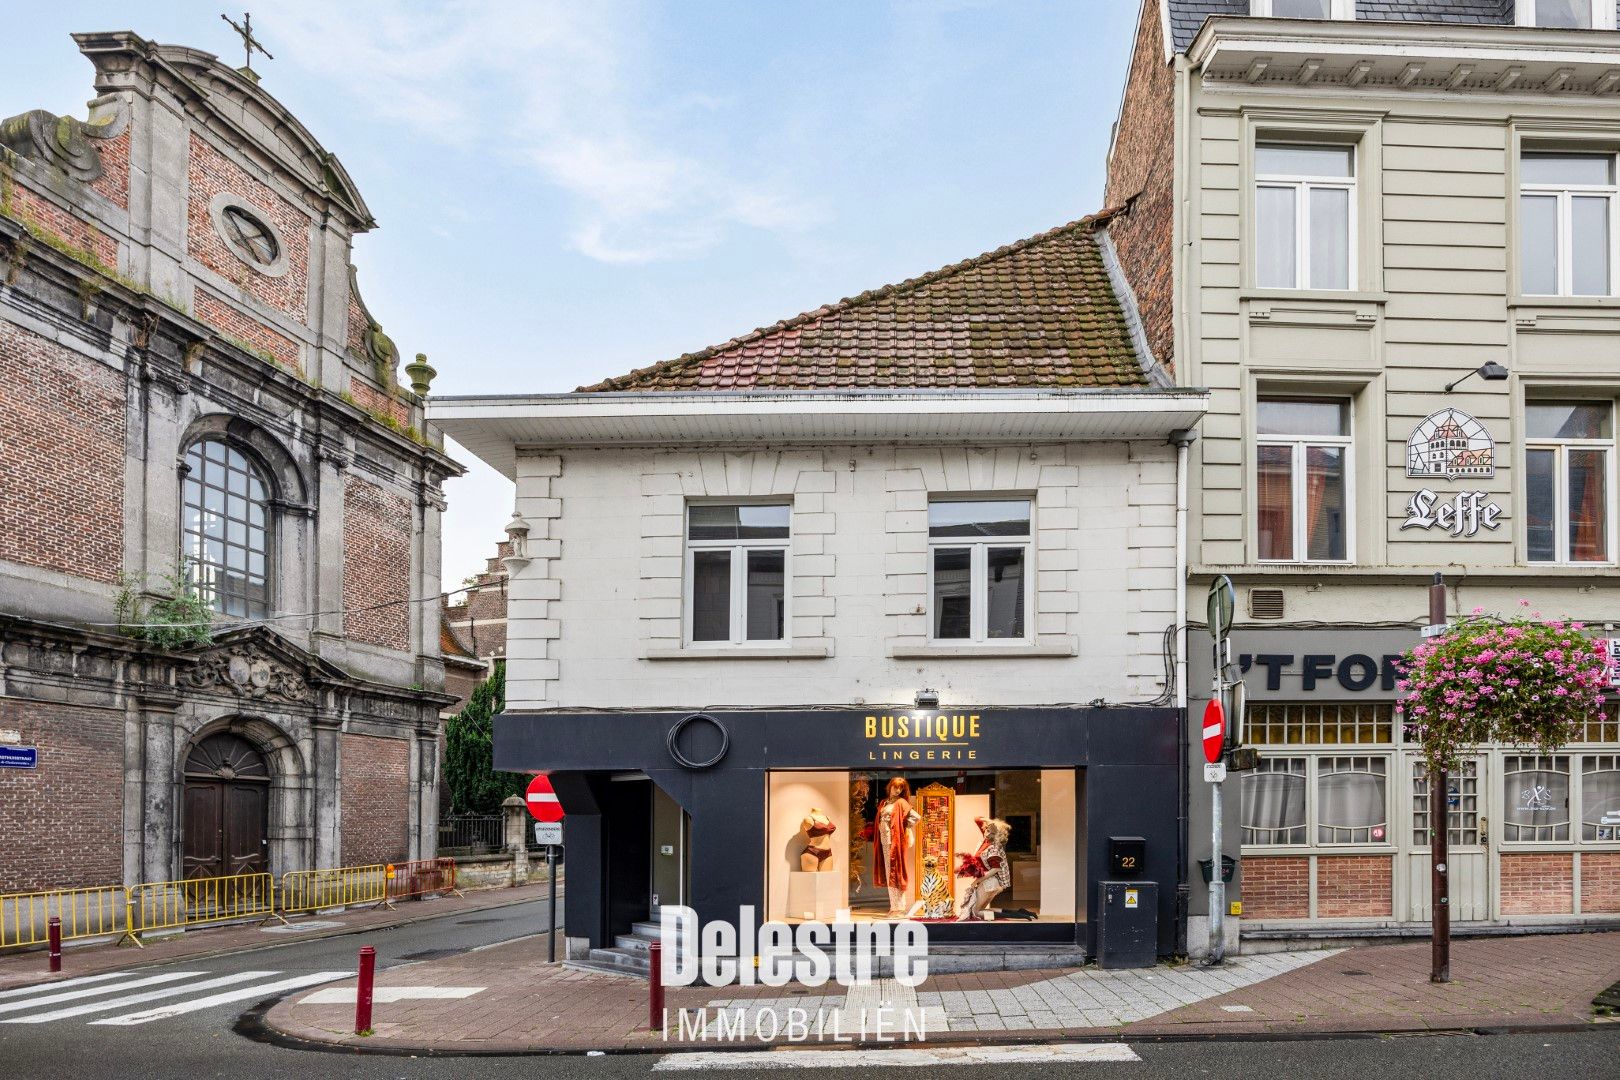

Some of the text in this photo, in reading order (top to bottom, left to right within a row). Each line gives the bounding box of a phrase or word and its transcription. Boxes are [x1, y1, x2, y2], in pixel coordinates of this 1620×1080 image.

[1400, 488, 1502, 538] Leffe
[865, 715, 980, 741] BUSTIQUE
[869, 750, 977, 760] LINGERIE
[1122, 856, 1136, 868] 22
